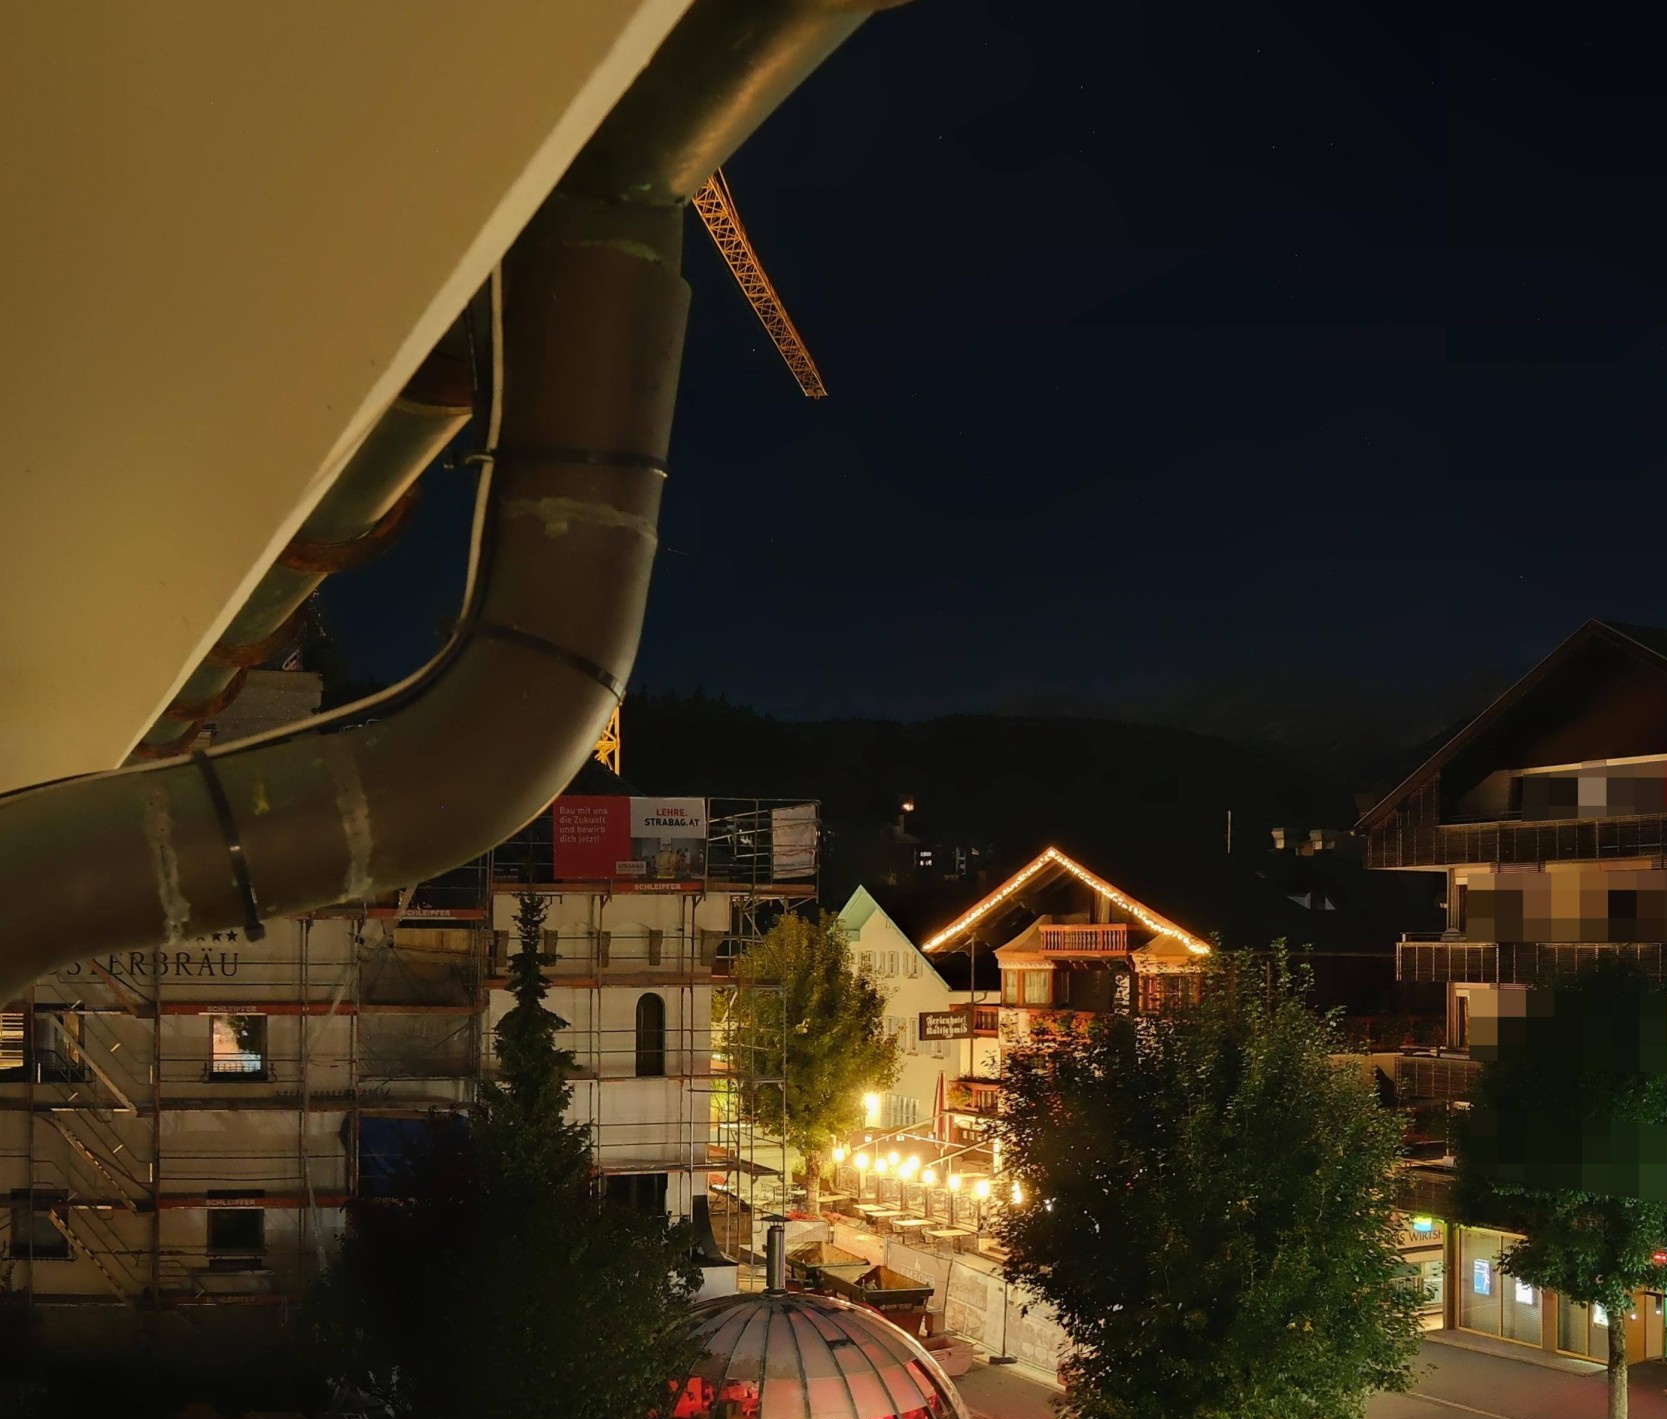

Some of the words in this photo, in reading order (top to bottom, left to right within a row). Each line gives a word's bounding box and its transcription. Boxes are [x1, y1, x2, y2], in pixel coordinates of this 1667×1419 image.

[559, 807, 575, 815] Bau
[577, 806, 591, 815] mit
[656, 808, 688, 817] LEHRE.
[559, 816, 572, 824] die
[574, 816, 606, 824] Zukunft
[644, 818, 700, 826] STRABAG.AT
[559, 825, 575, 834] und
[577, 825, 606, 834] bewirb
[559, 834, 576, 843] dich
[578, 834, 600, 845] jetzt!
[206, 1005, 257, 1013] SCHLEIPFER
